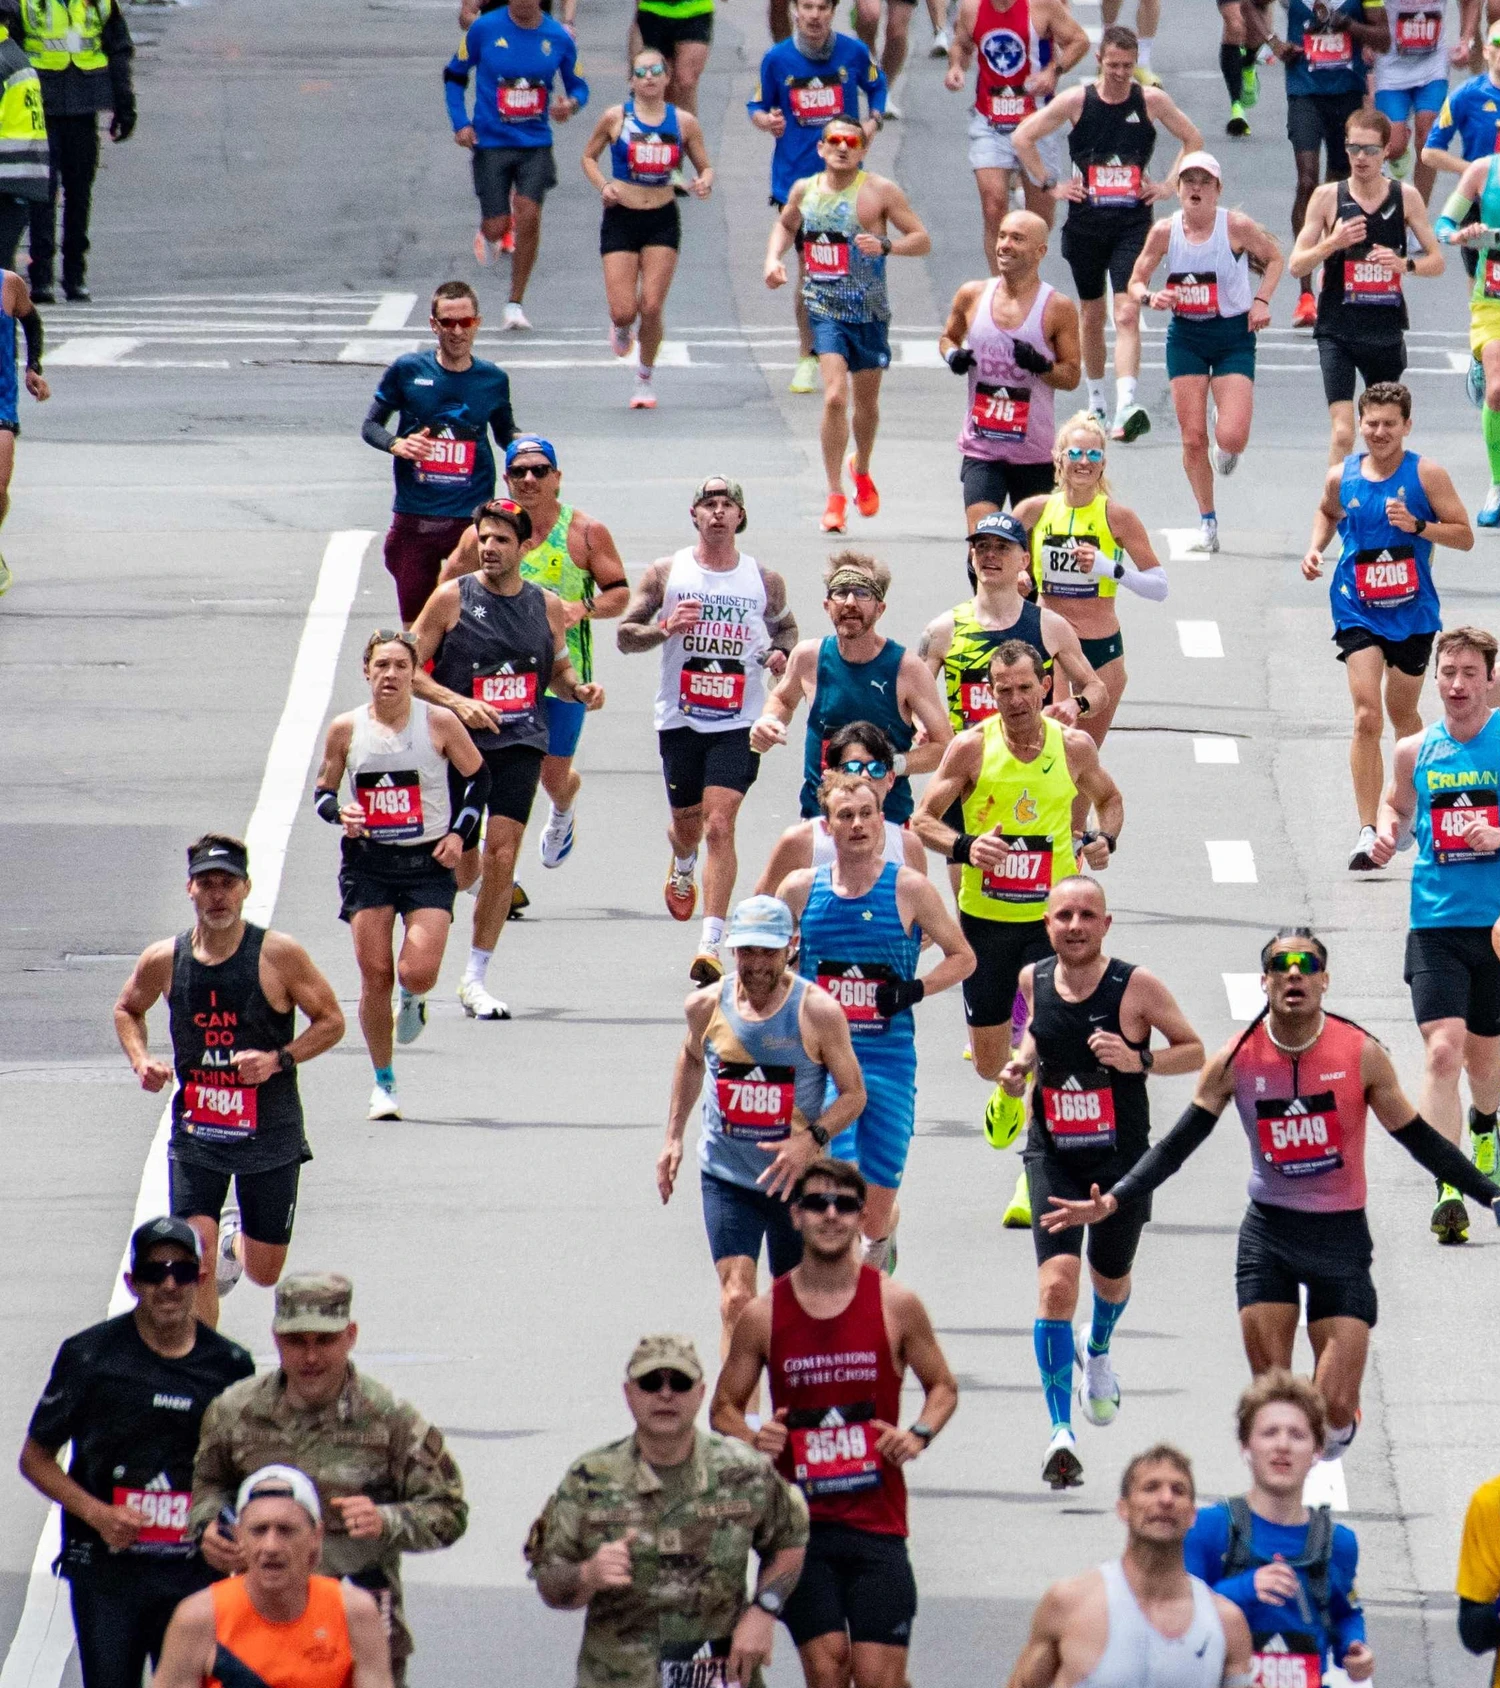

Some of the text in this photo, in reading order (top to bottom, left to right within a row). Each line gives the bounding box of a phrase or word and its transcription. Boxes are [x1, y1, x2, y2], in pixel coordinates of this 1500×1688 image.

[976, 513, 1013, 531] ciele
[1364, 562, 1409, 589] 4206
[677, 592, 758, 611] MASSACHUSETTS
[697, 606, 748, 624] RMY
[682, 635, 744, 658] GUARD
[483, 676, 527, 702] 6238
[689, 673, 736, 699] 5556
[364, 788, 411, 816] 7493
[1435, 809, 1489, 838] 485
[210, 989, 216, 1007] I
[193, 1011, 237, 1028] CAN
[204, 1030, 235, 1046] DO
[193, 1086, 245, 1117] 7384
[727, 1083, 782, 1115] 7686
[1053, 1092, 1102, 1122] 1668
[1270, 1115, 1329, 1150] 5449
[784, 1351, 877, 1371] COMPANIONS
[803, 1370, 833, 1386] THE
[834, 1367, 878, 1384] CROSS
[153, 1392, 193, 1411] BANDIT
[805, 1425, 869, 1464] 3549
